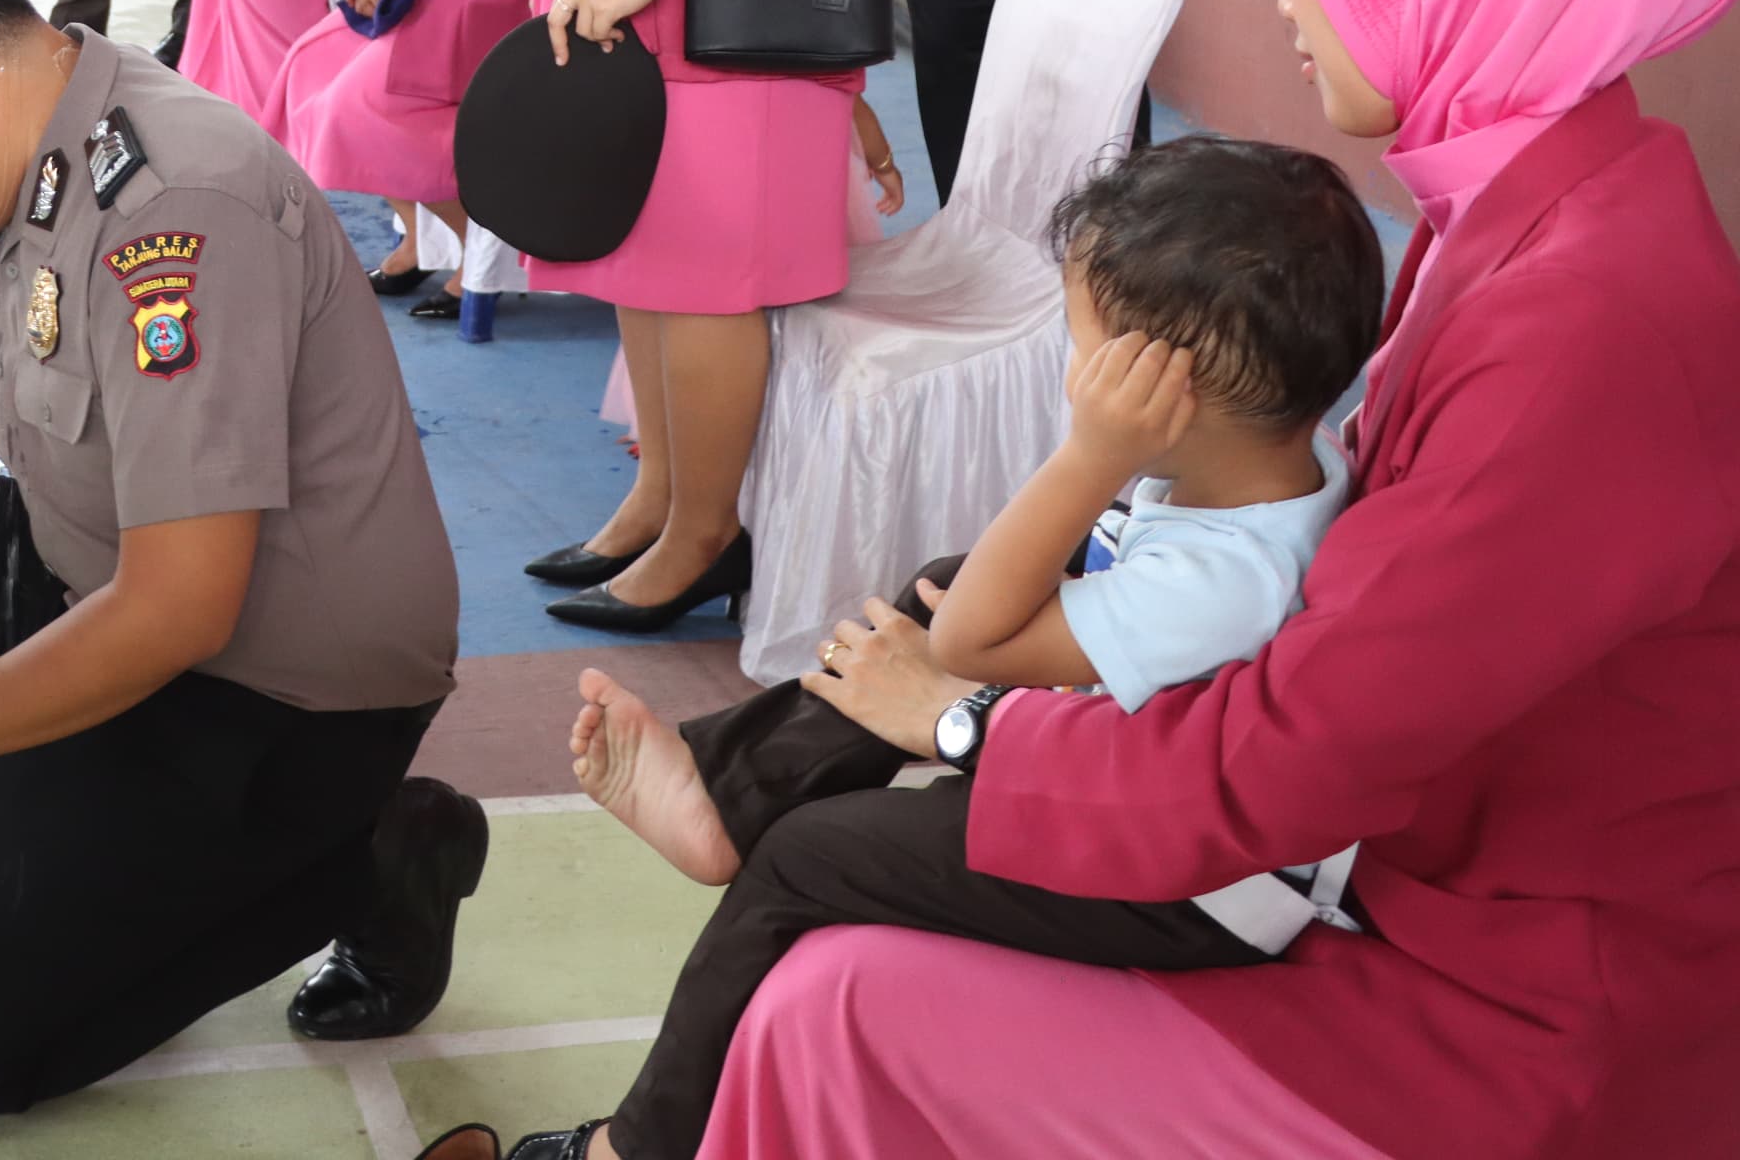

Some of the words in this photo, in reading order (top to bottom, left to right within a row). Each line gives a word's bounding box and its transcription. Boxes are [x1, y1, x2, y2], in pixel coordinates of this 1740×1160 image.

[110, 235, 199, 268] POLRES
[118, 248, 161, 273] TANJUNG
[162, 245, 194, 259] BALAI
